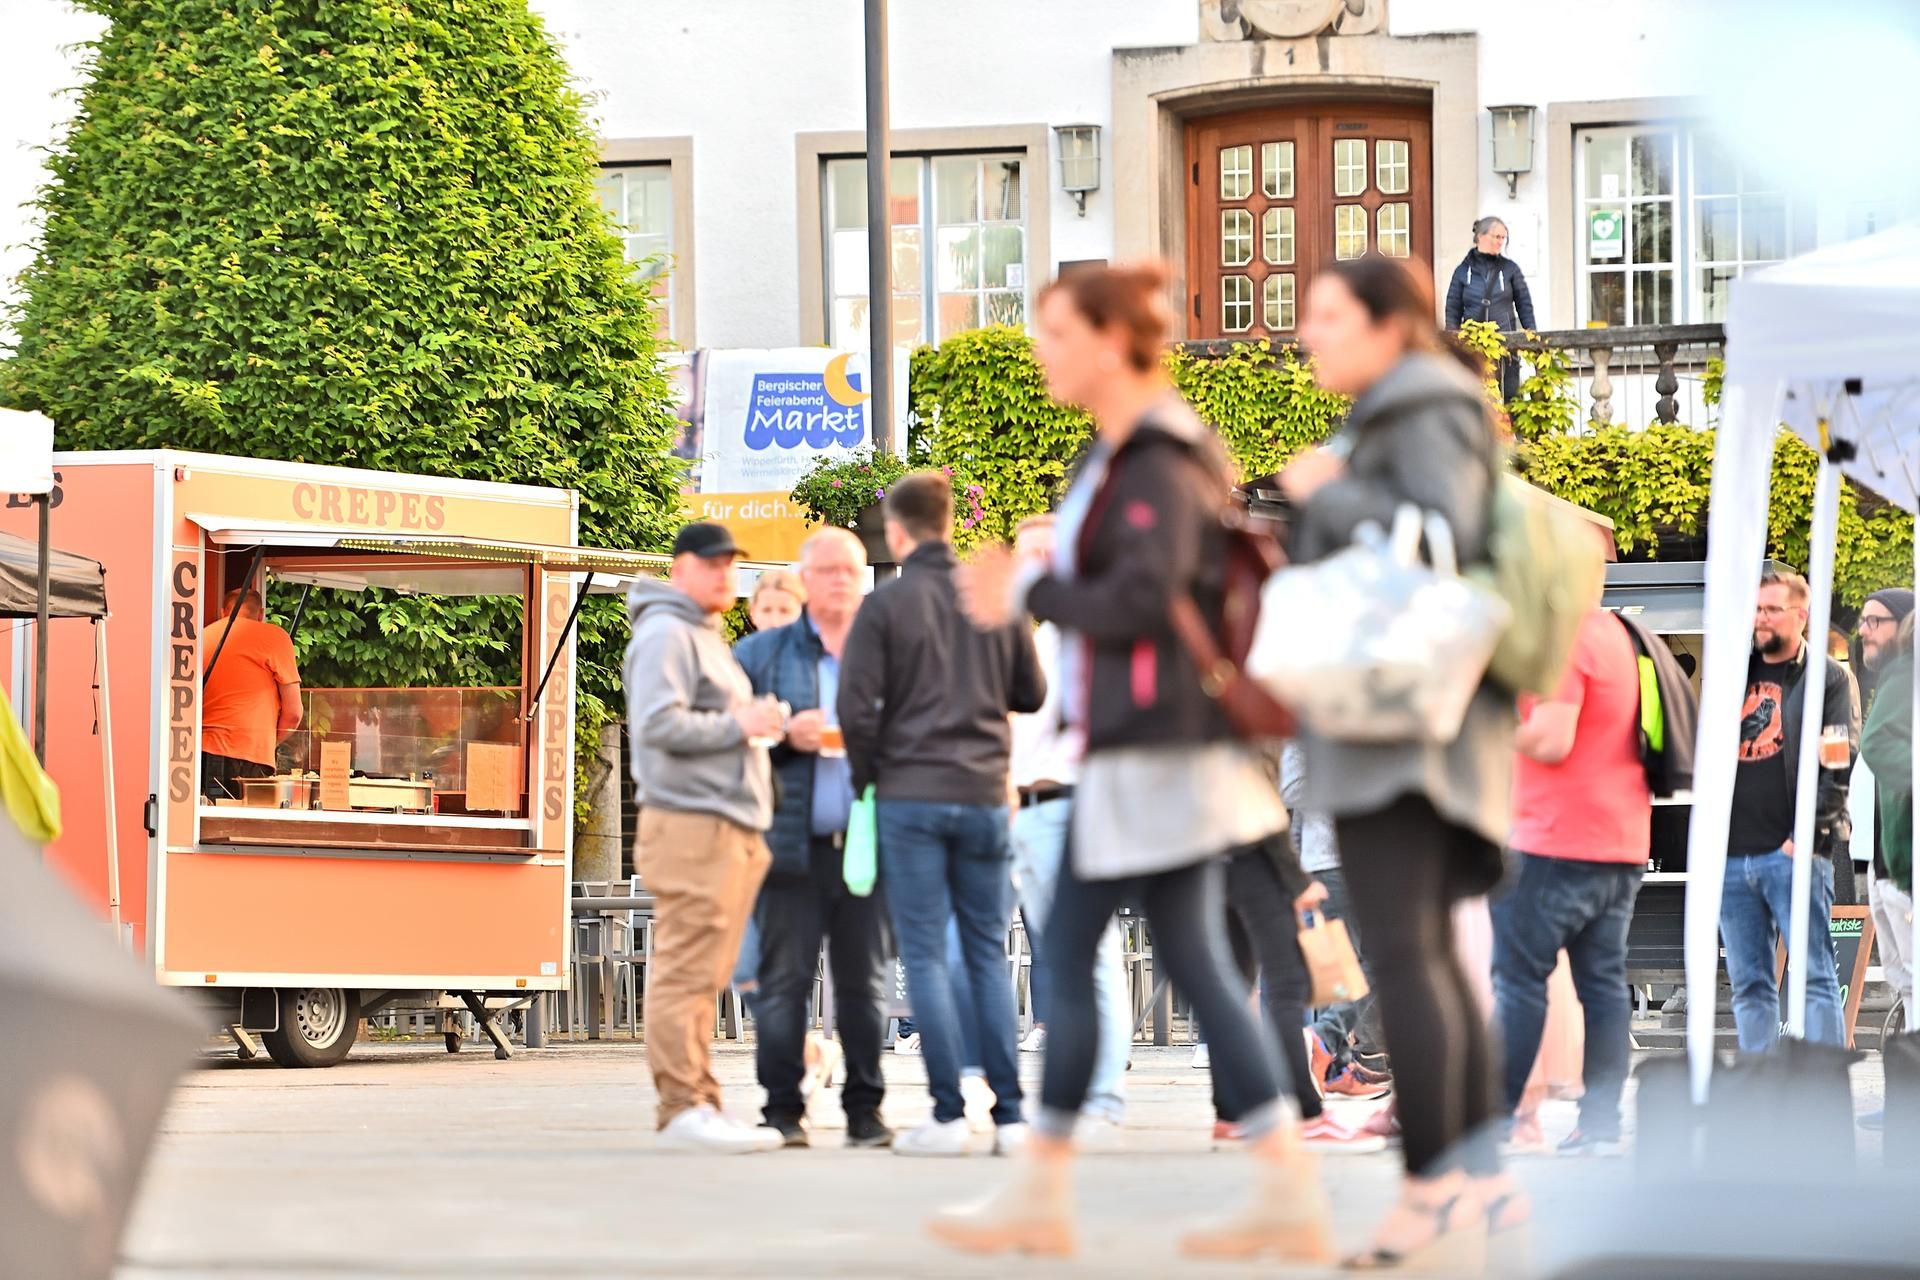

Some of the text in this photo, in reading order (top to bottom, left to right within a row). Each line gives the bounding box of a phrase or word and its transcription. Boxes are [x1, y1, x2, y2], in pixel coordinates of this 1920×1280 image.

[1284, 47, 1294, 65] 1
[757, 380, 822, 392] Bergischer
[757, 395, 824, 407] Feierabend
[750, 406, 861, 433] Markt
[293, 482, 445, 530] CREPES
[703, 501, 733, 519] für
[170, 561, 197, 803] CREPES
